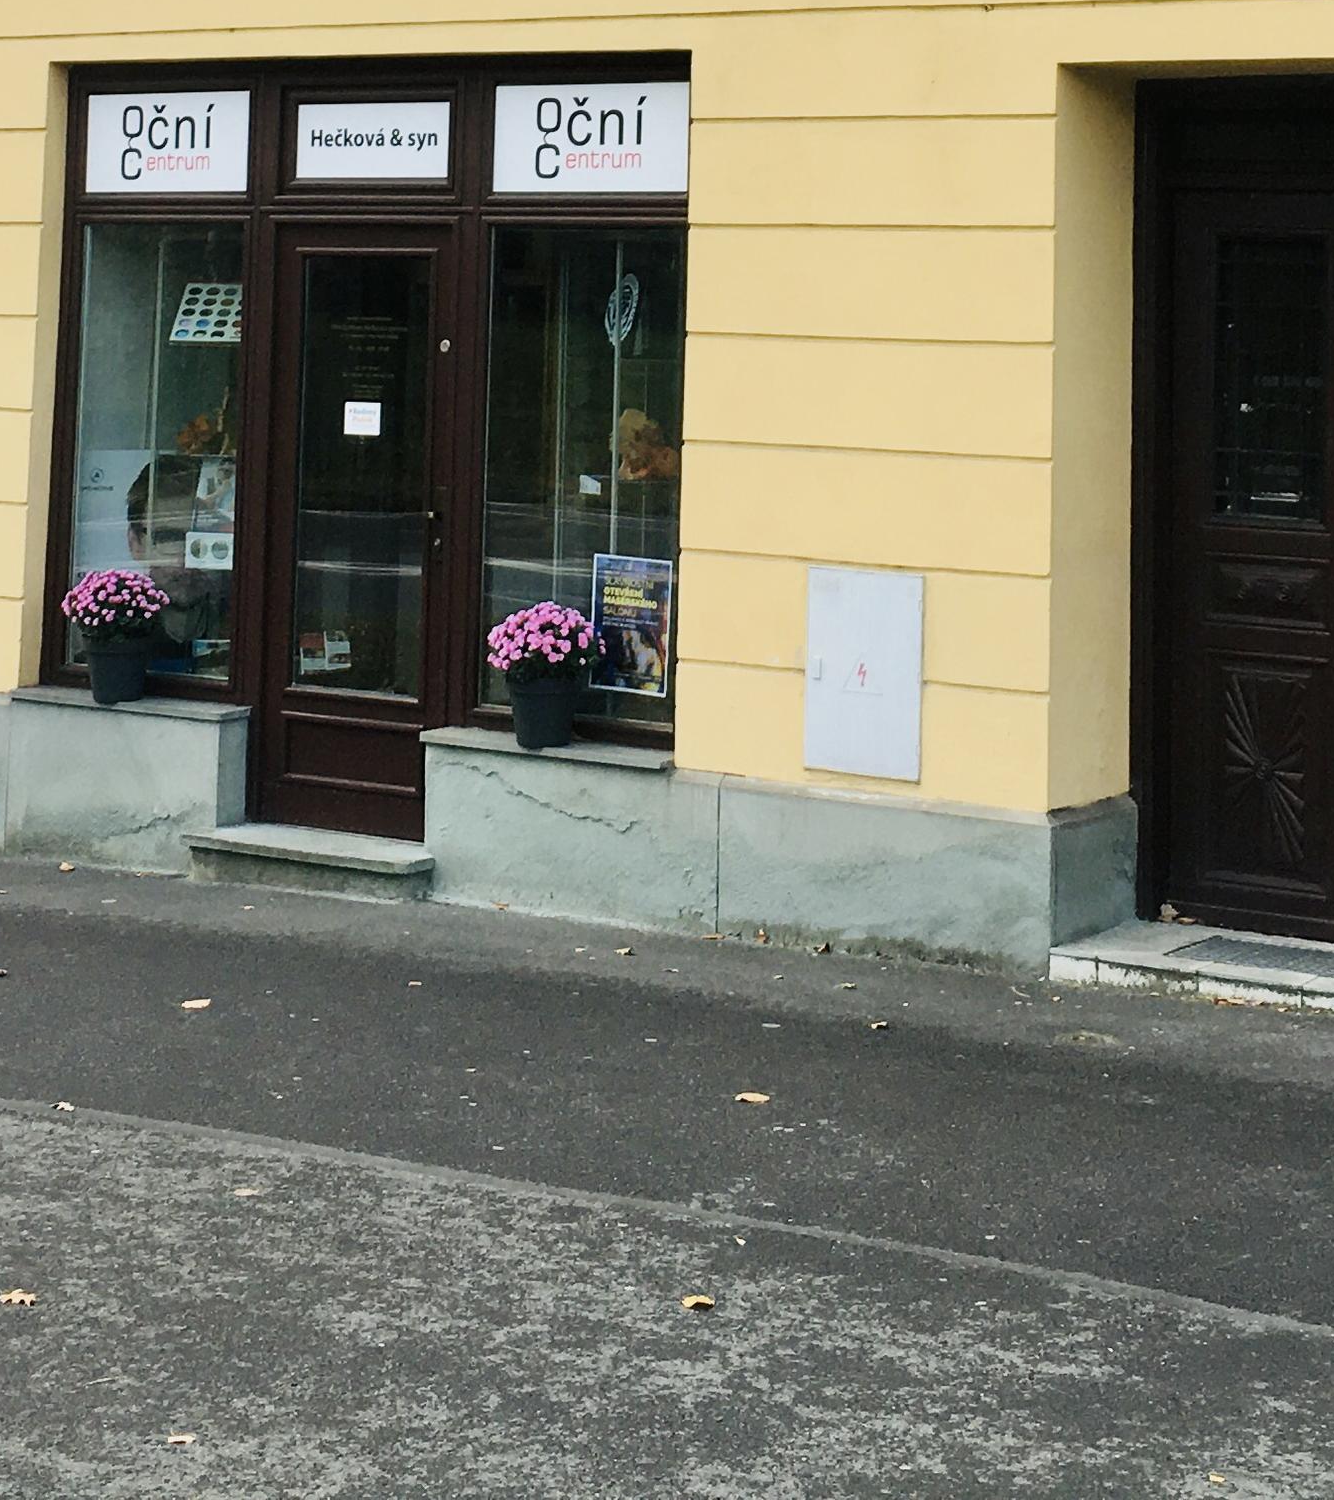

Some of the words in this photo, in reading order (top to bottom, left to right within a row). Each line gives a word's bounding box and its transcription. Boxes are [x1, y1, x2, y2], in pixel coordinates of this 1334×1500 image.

[310, 128, 386, 148] Hečková
[390, 128, 403, 147] &
[408, 131, 439, 149] syn
